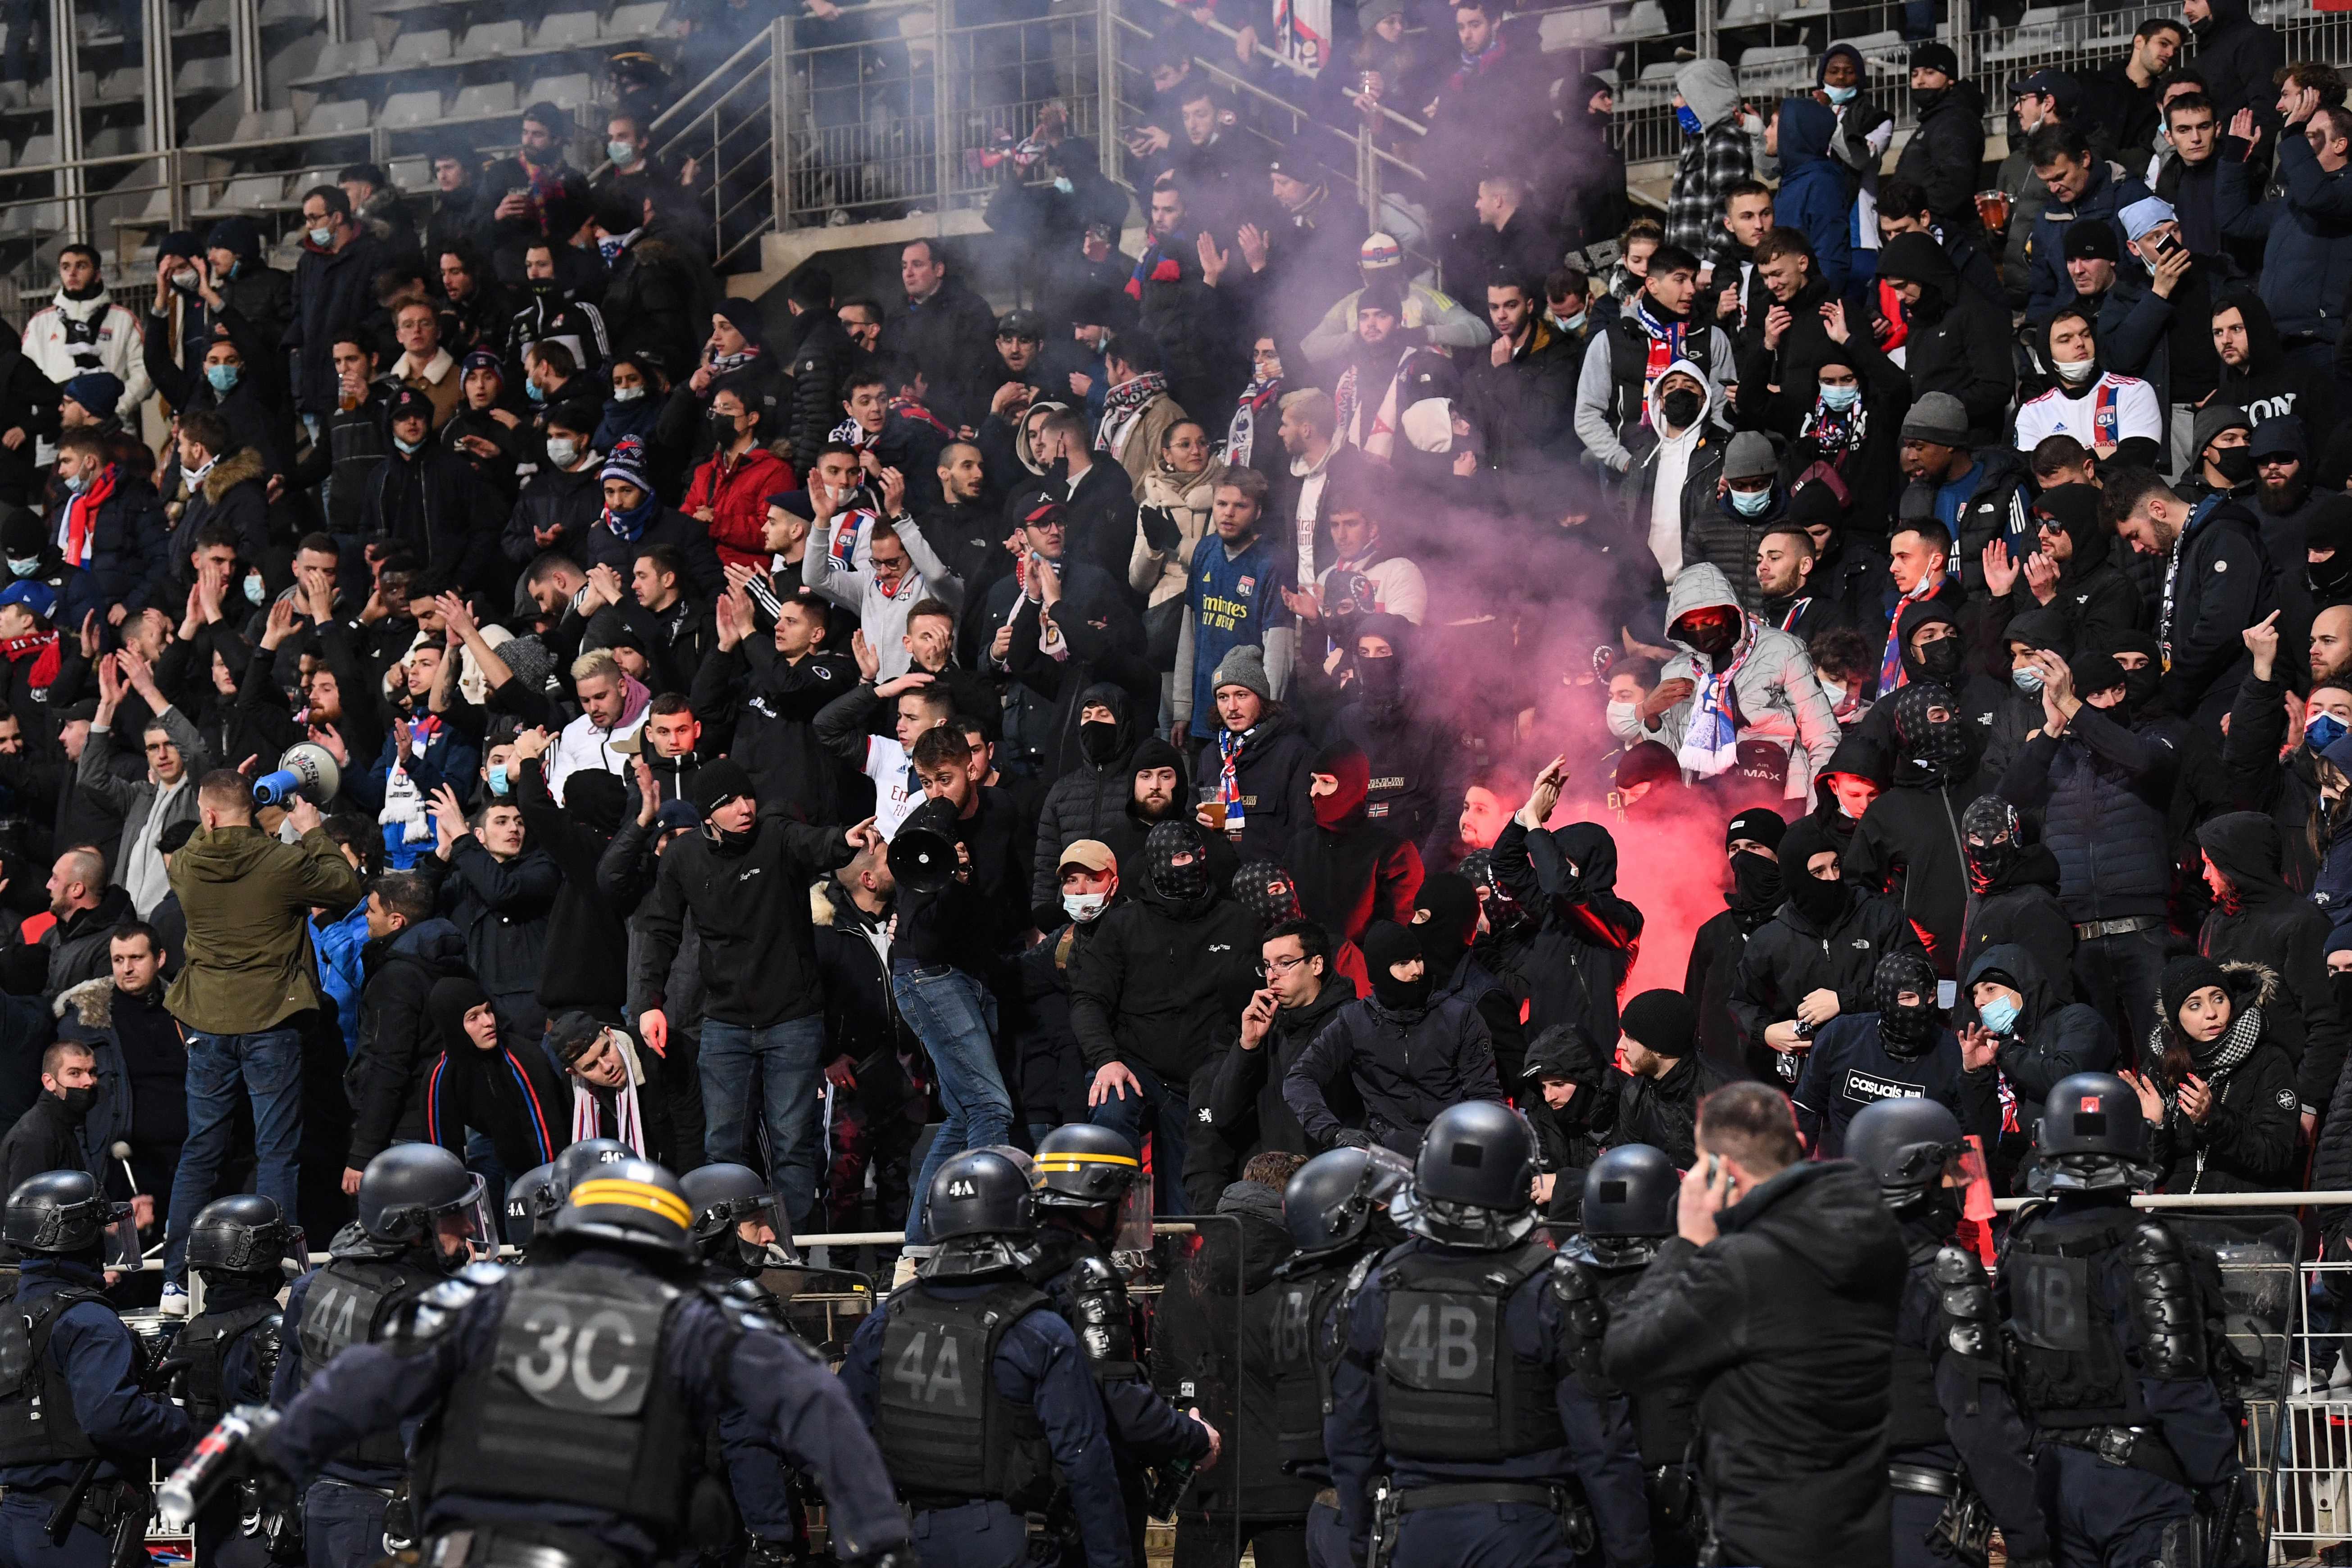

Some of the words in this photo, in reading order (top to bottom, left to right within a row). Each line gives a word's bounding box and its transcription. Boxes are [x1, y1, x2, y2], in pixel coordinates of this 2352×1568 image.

[2240, 393, 2297, 427] ON
[2098, 414, 2113, 424] OL
[839, 535, 852, 544] OL
[1238, 584, 1250, 595] OL
[1744, 769, 1780, 781] MAX
[1368, 777, 1405, 789] PAPIJRI
[1849, 1077, 1903, 1099] casuals
[949, 1180, 976, 1196] 4A
[508, 1202, 526, 1217] 4A
[1398, 1304, 1478, 1380] 4B
[516, 1304, 636, 1401] 3C
[893, 1332, 967, 1407] 4A
